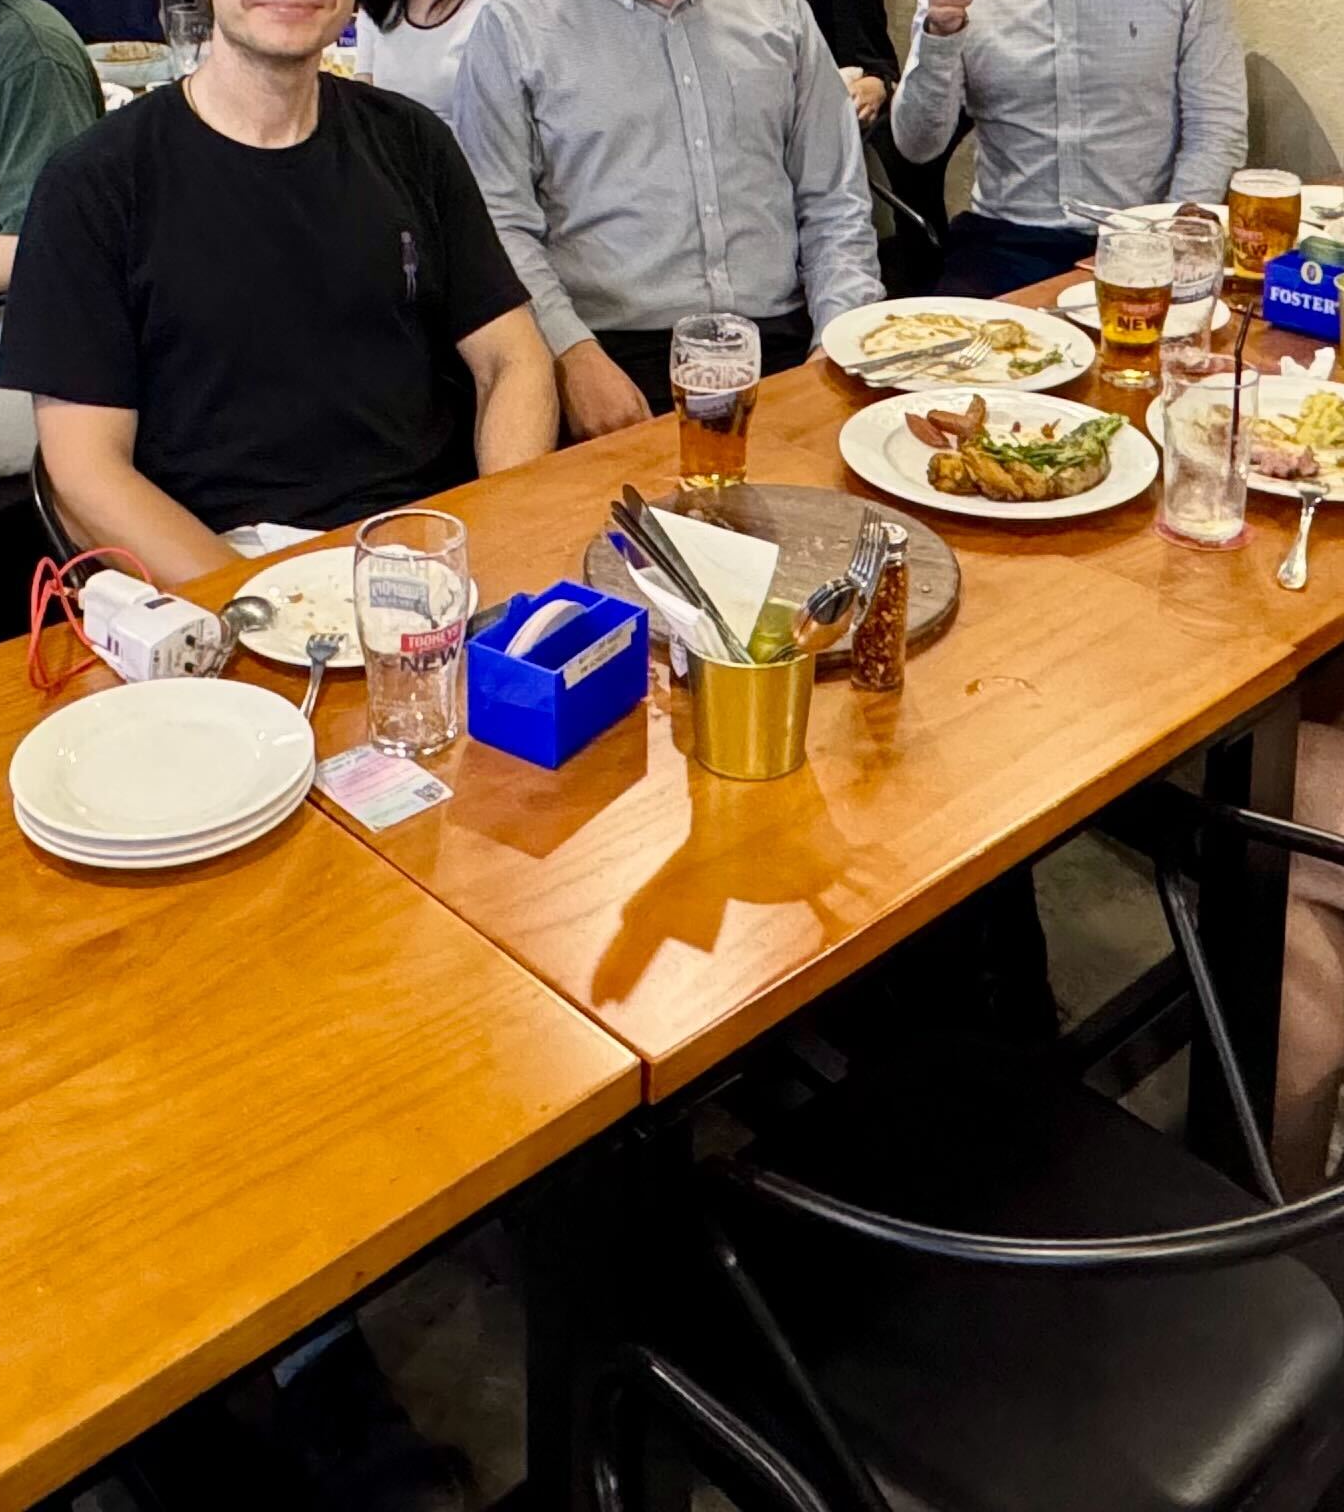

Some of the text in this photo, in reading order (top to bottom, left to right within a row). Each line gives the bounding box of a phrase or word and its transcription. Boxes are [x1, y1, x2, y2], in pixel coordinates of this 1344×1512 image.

[1269, 285, 1339, 315] FOSTER'
[1117, 315, 1162, 332] NEW
[400, 642, 459, 673] NEW
